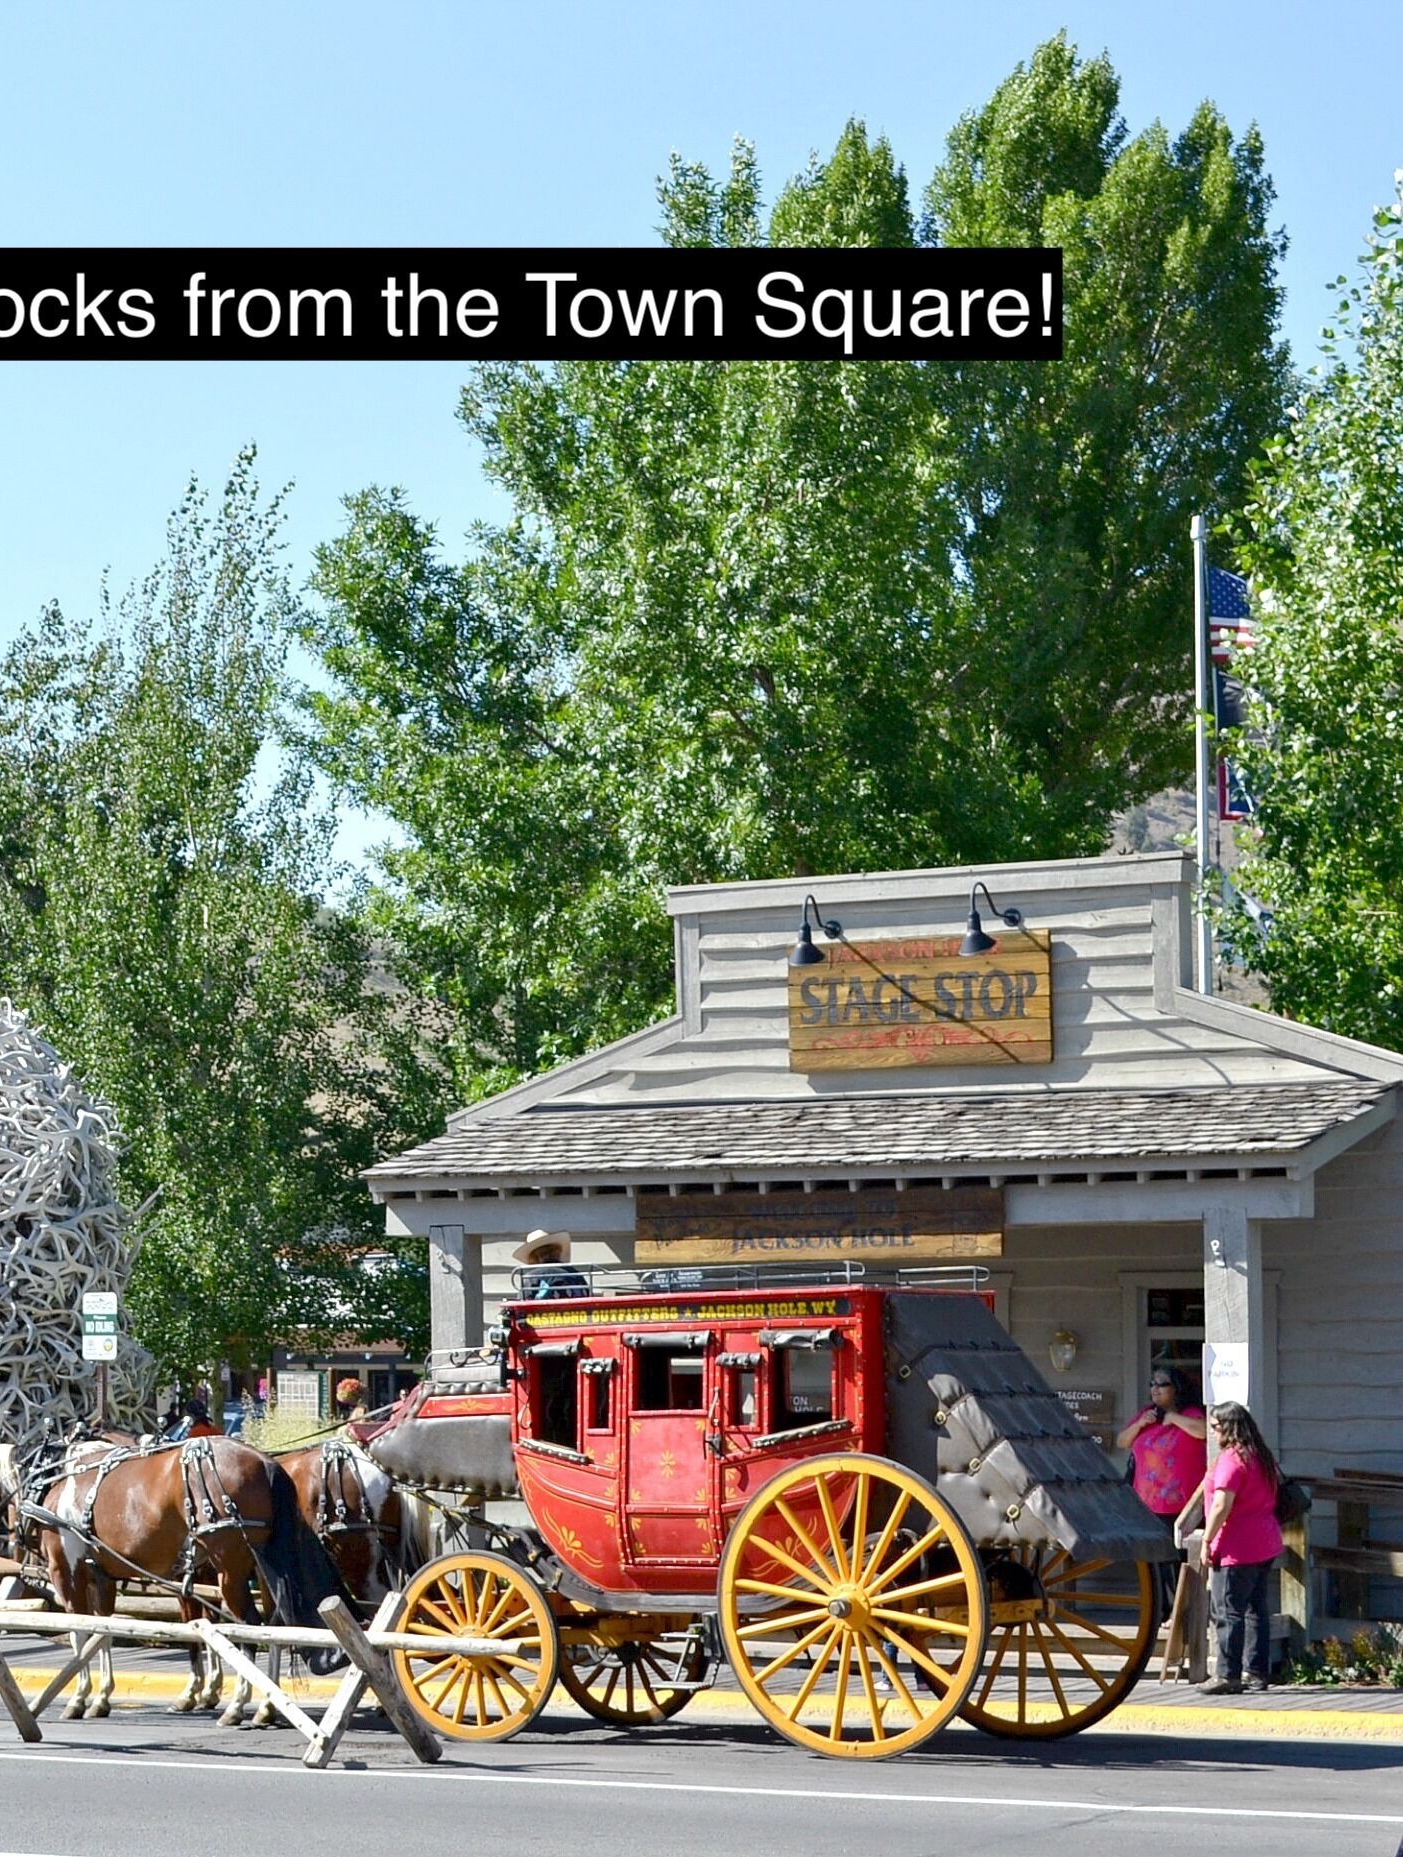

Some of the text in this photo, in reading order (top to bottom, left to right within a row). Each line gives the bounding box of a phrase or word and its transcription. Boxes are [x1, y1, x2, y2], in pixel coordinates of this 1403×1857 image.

[800, 969, 1038, 1026] STAGE STOP
[732, 1224, 915, 1254] JACKSON HOLE
[591, 1306, 679, 1323] OUTFITTERS
[698, 1303, 765, 1319] JACKSON
[1055, 1391, 1103, 1400] TAGECOACH
